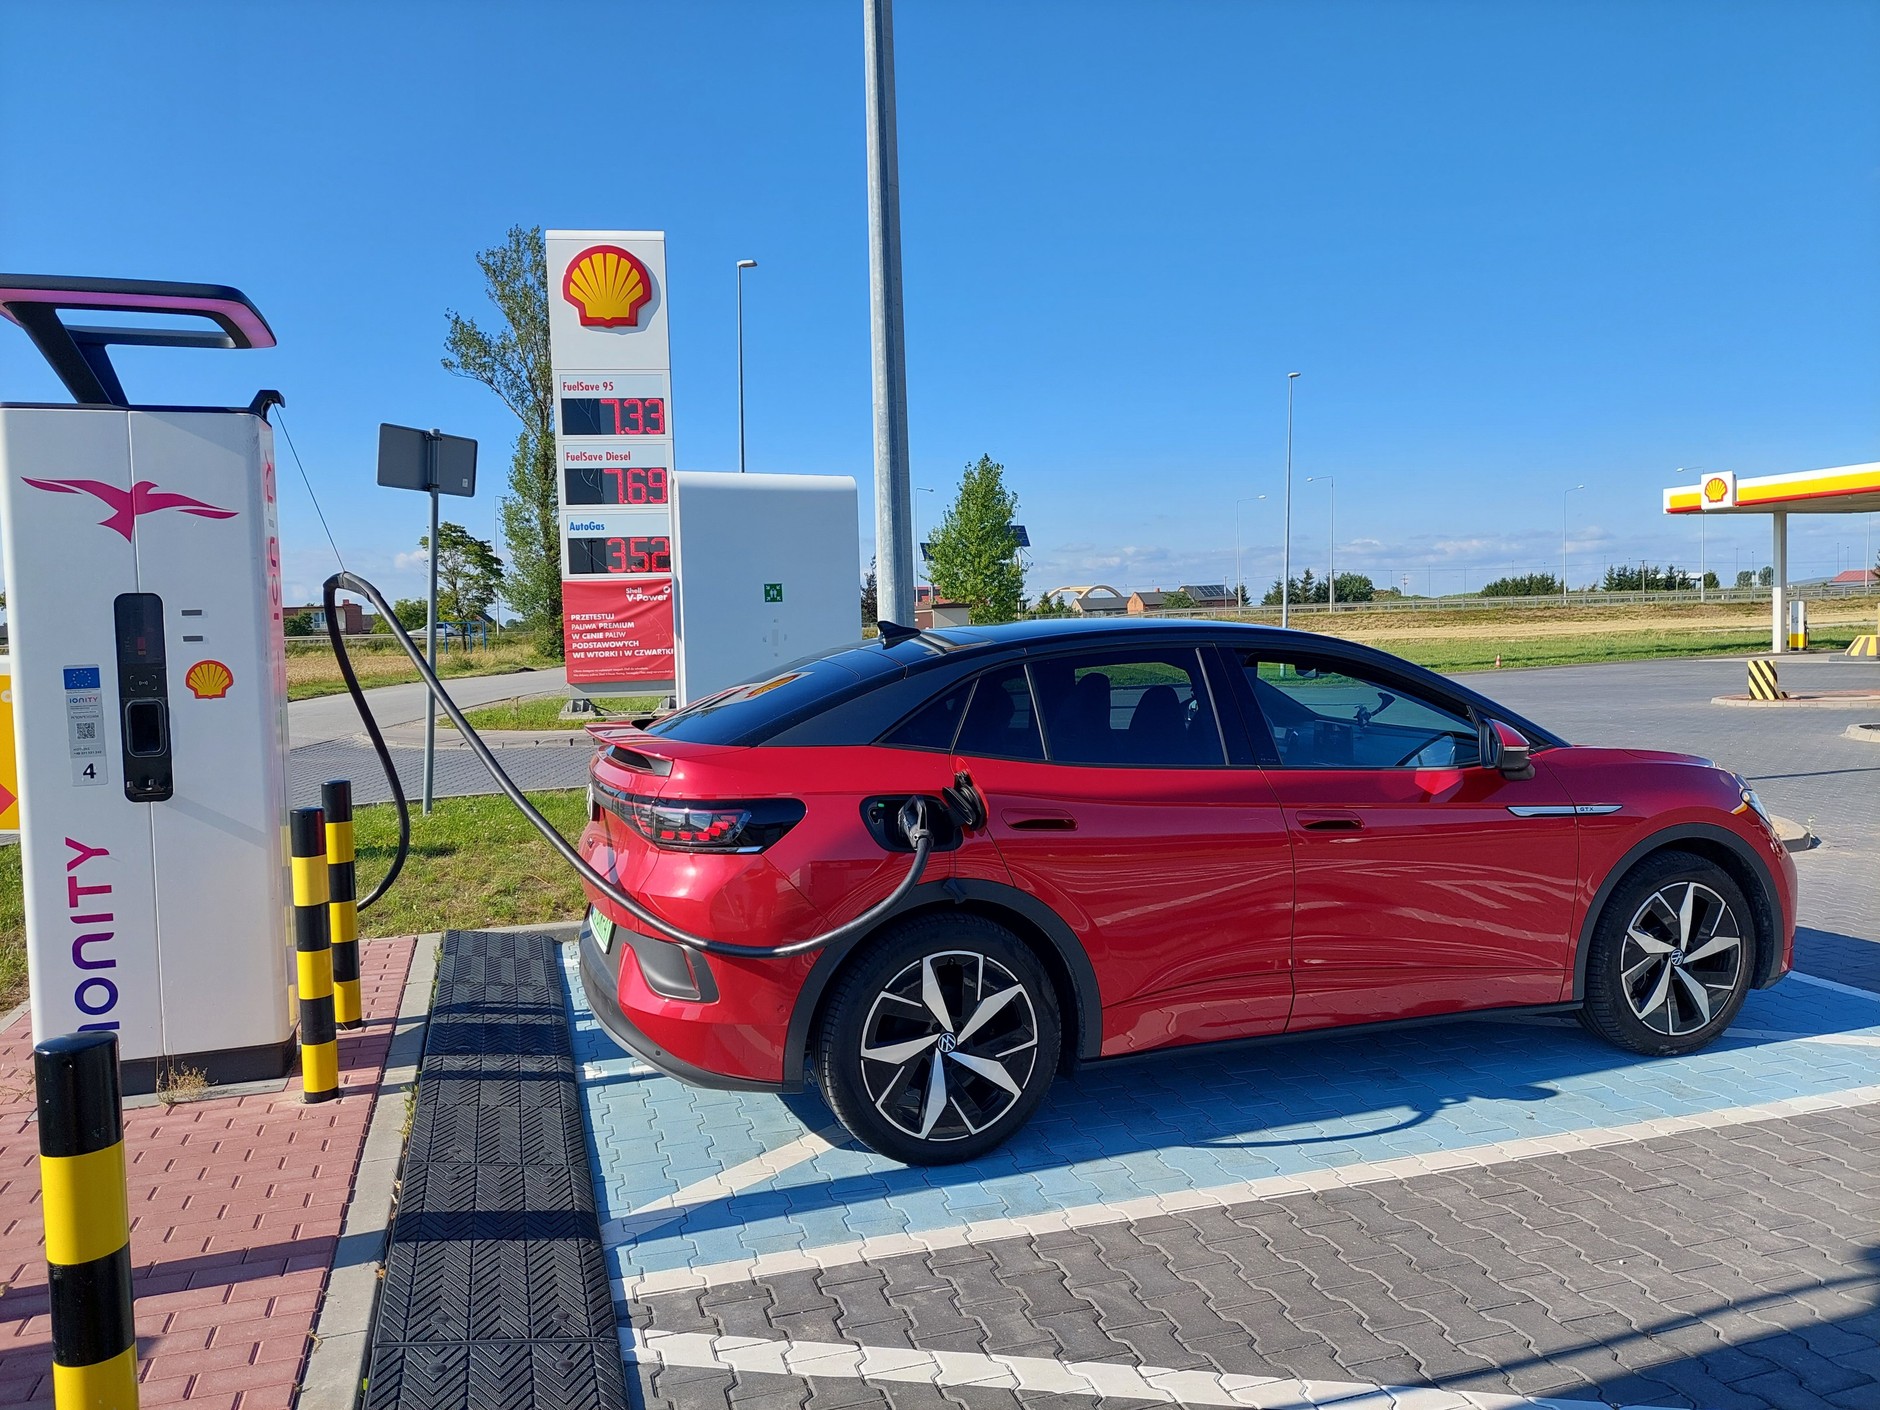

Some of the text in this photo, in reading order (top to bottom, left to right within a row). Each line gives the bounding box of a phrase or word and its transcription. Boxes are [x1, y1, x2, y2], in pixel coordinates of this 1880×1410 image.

[562, 381, 614, 391] FuelSave 95
[600, 398, 665, 435] 7.33
[566, 451, 631, 461] FuelSave Diesel
[603, 468, 668, 504] 7.69
[569, 522, 605, 532] AutoGas
[606, 537, 670, 574] 3.52
[626, 594, 668, 602] V-Power
[571, 613, 615, 621] PRZETESTUJ
[598, 621, 635, 629] PREMIUM
[605, 631, 626, 639] PALIW
[572, 640, 639, 649] PODSTAWOWYCH
[586, 650, 618, 658] WTORKI
[634, 648, 674, 656] CZWARTKI
[82, 762, 97, 779] 4
[65, 836, 120, 1032] IONITY
